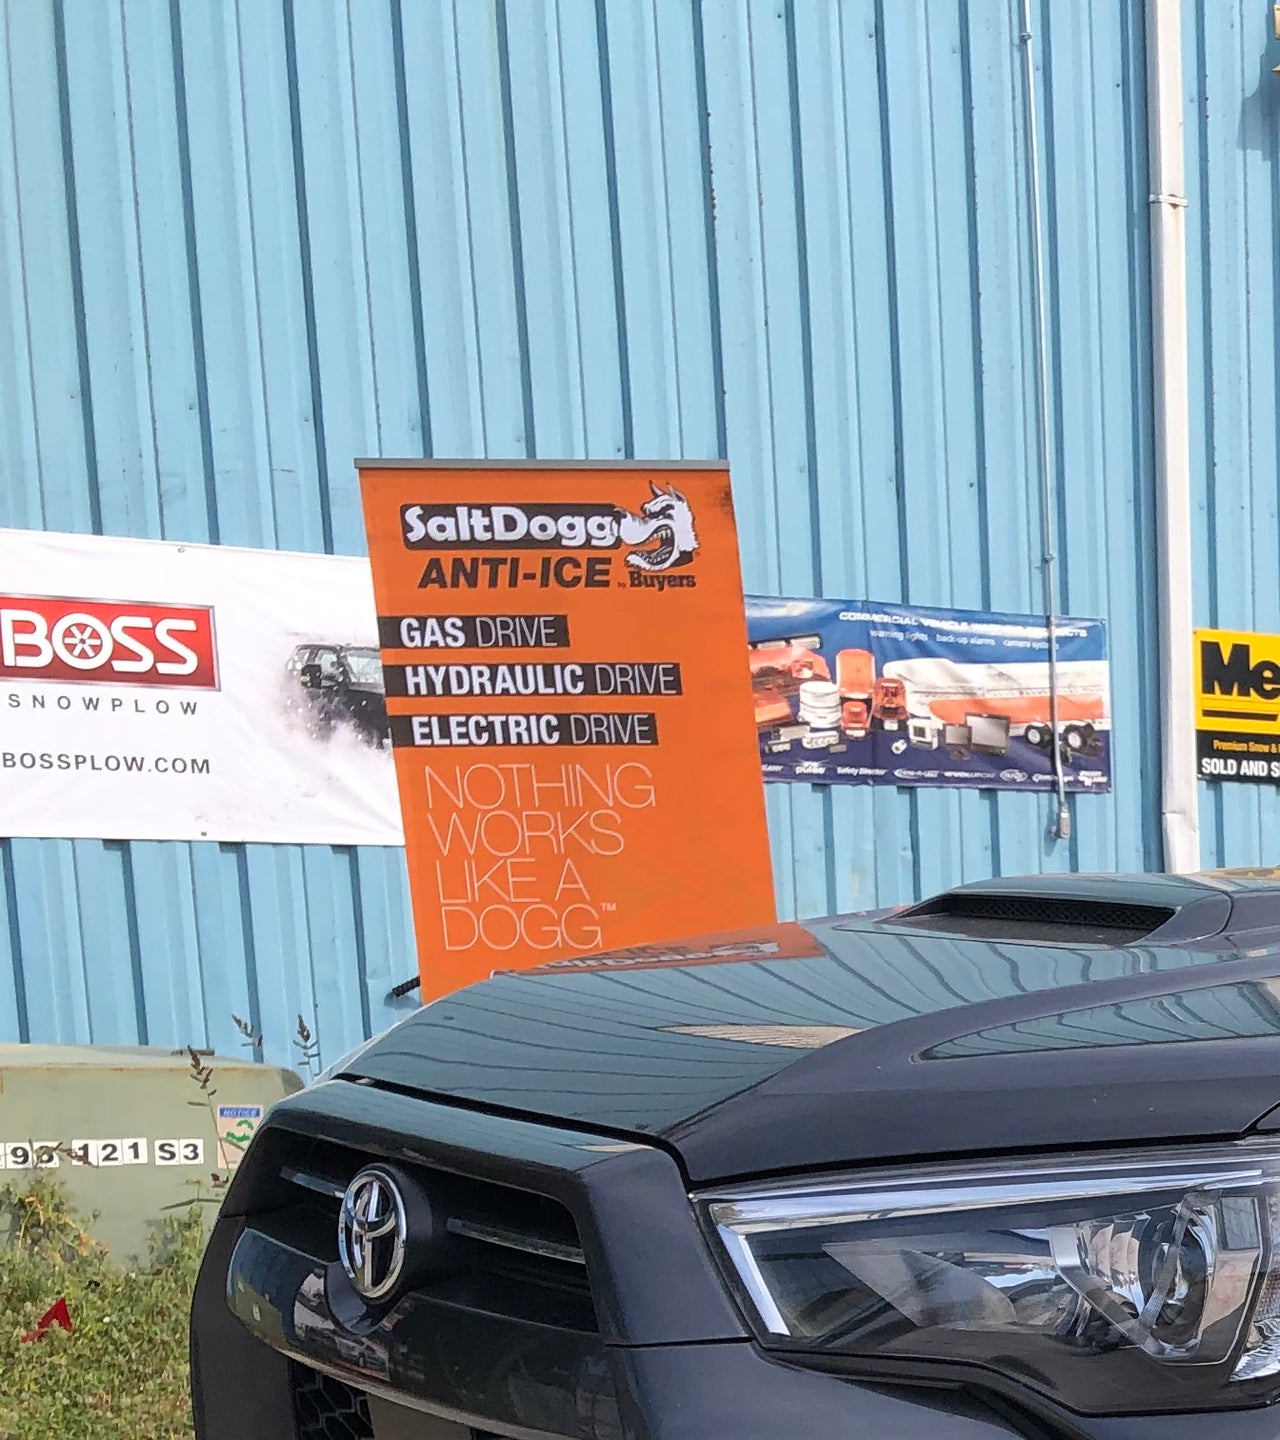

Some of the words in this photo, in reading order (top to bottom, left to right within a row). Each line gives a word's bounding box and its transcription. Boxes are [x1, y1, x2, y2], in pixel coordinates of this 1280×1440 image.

[404, 505, 618, 546] SaltDogg
[417, 557, 612, 589] ANTI-ICE
[628, 570, 697, 592] Buyers
[400, 617, 466, 648] GAS
[475, 616, 558, 647] DRIVE
[838, 610, 919, 626] COMMERCIAL
[0, 609, 198, 676] BOSS
[404, 664, 586, 696] HYDRAULIC
[594, 664, 677, 694] DRIVE
[8, 693, 198, 715] SNOWPLOW
[411, 715, 560, 745] ELECTRIC
[569, 714, 652, 744] DRIVE
[2, 752, 210, 774] BOSSPLOW.COM
[1248, 742, 1270, 753] Snow
[1201, 757, 1237, 775] SOLD
[1240, 760, 1268, 777] AND
[424, 761, 656, 809] NOTHING
[427, 810, 624, 857] WORKS
[435, 858, 541, 904] LIKE
[554, 857, 591, 902] A
[441, 903, 603, 951] DOGG
[158, 1143, 200, 1161] S3
